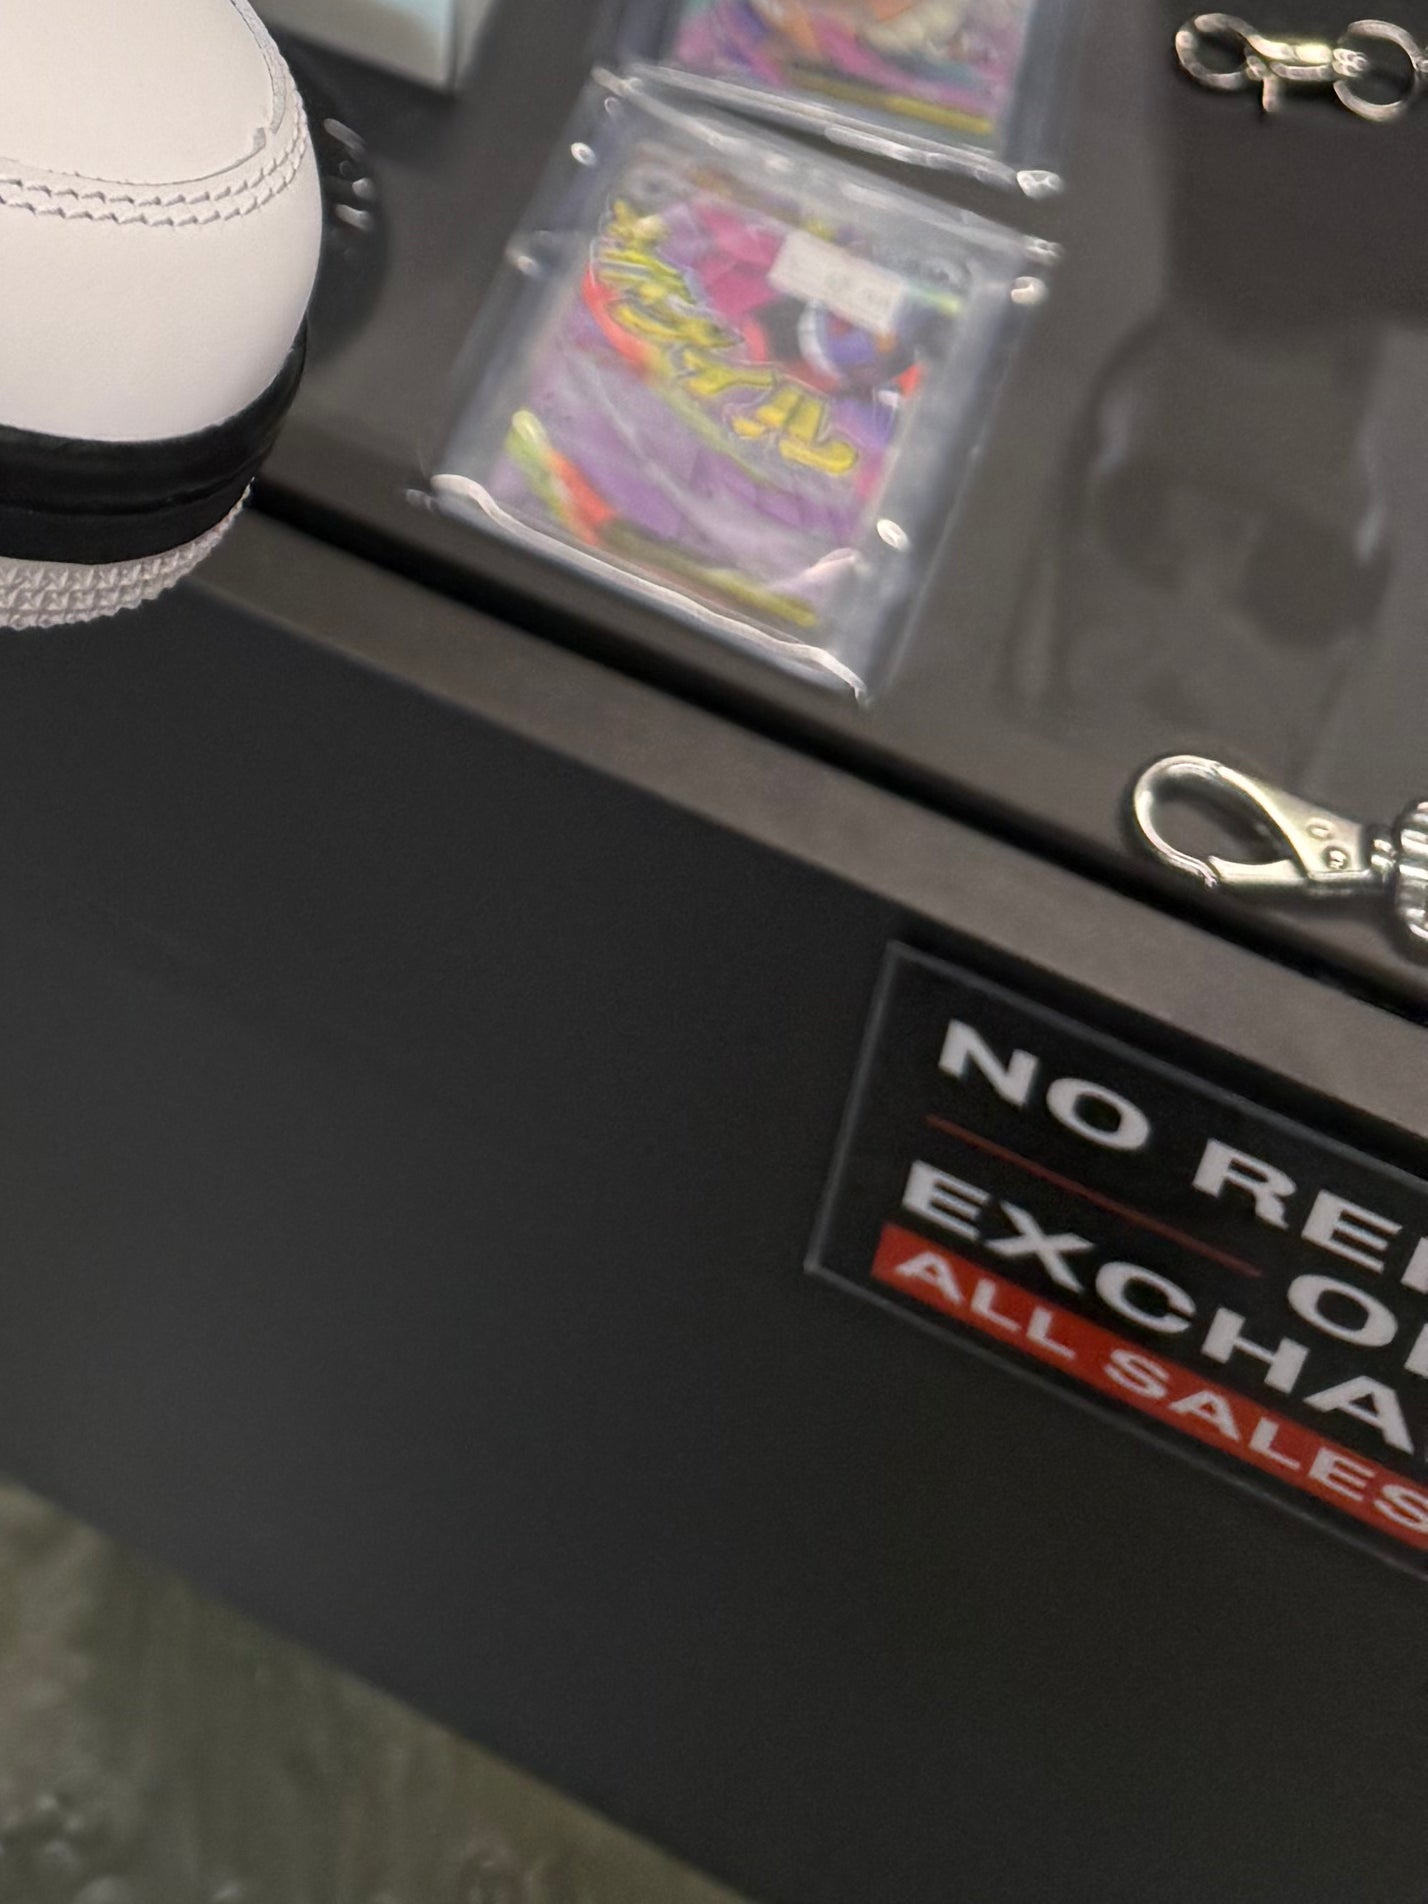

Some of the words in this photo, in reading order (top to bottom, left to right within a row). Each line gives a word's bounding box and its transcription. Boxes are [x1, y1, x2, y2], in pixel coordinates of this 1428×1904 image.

[938, 1018, 1151, 1152] NO
[893, 1250, 1078, 1362] ALL
[1102, 1348, 1428, 1535] SALES
[901, 1159, 1428, 1456] EXCHA
